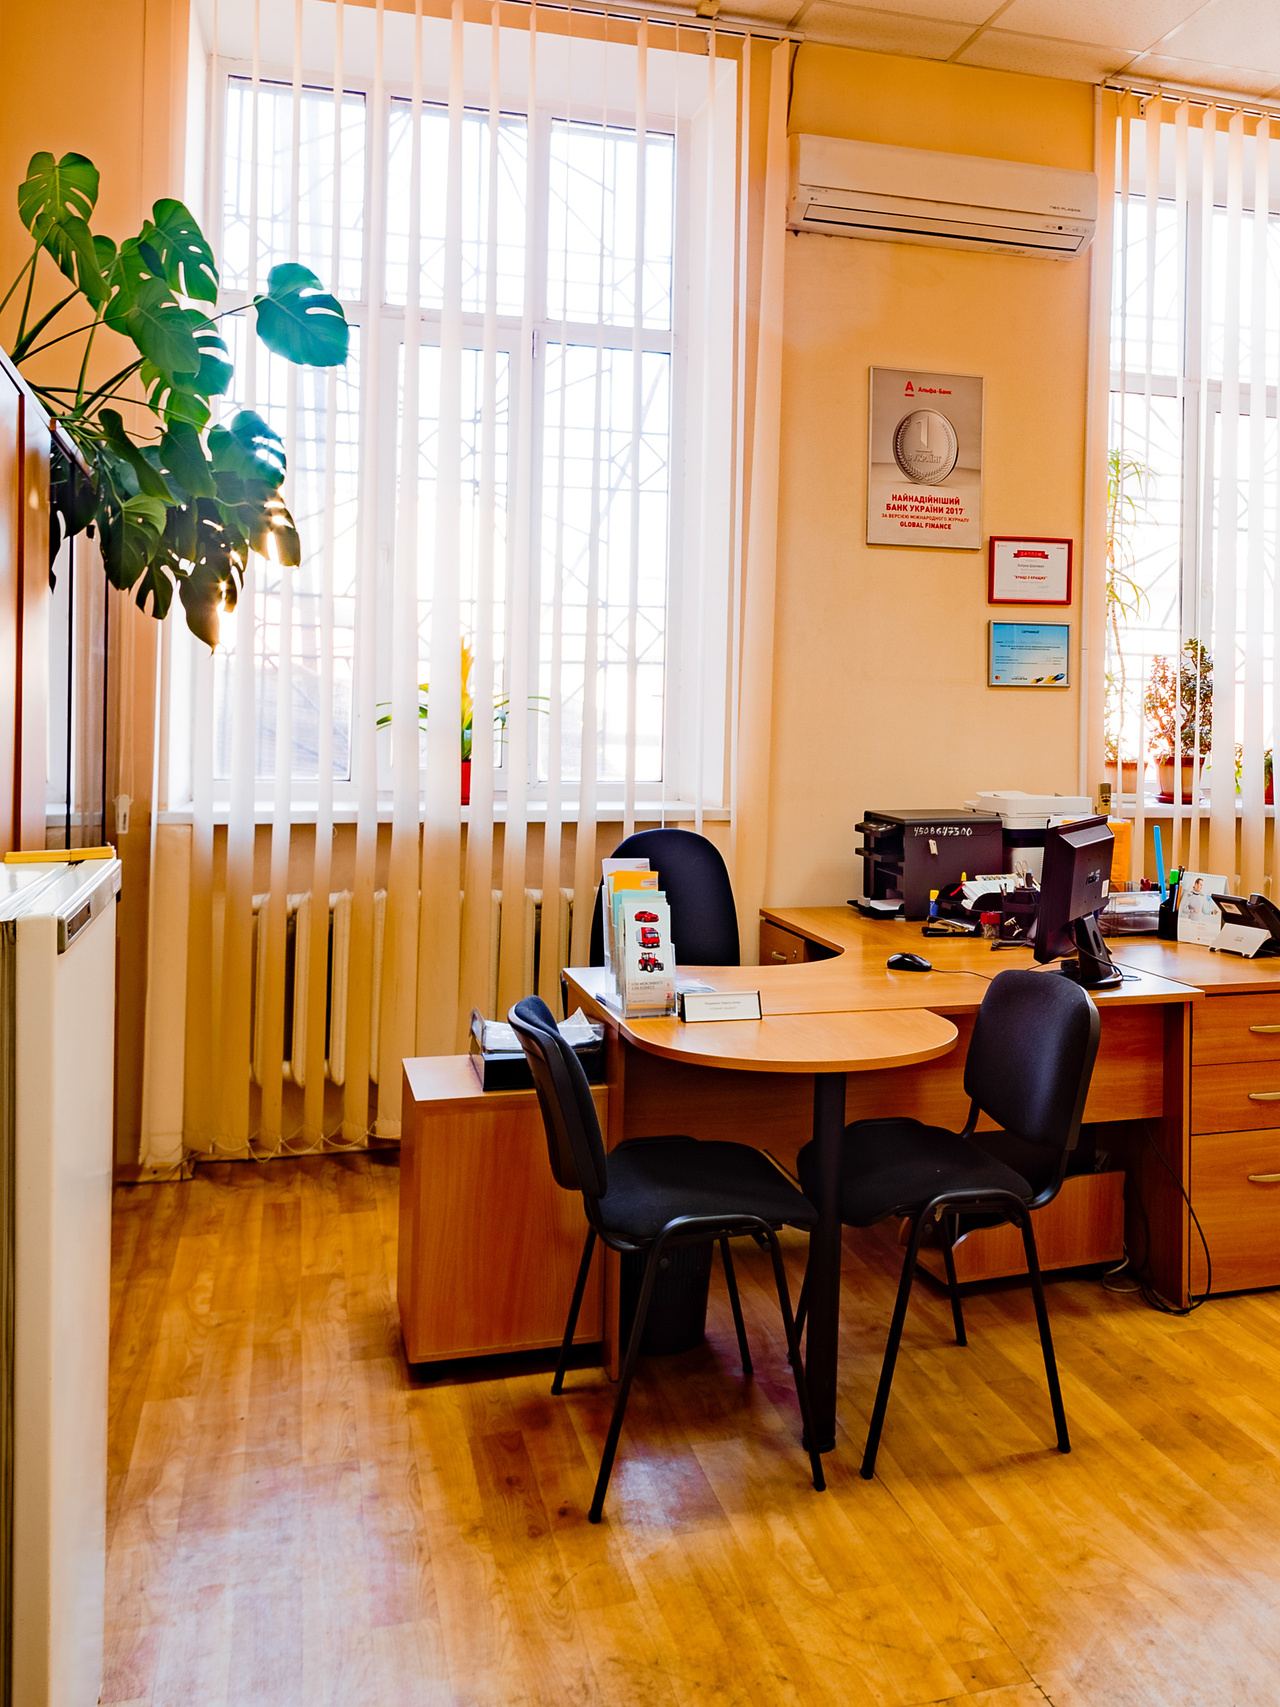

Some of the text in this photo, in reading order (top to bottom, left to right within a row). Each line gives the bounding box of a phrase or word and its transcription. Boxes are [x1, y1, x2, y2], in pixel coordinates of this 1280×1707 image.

[892, 493, 960, 505] НАЙНАДІЙНІШИЙ
[886, 503, 908, 512] БАНК
[910, 504, 944, 514] УКРАЇНИ
